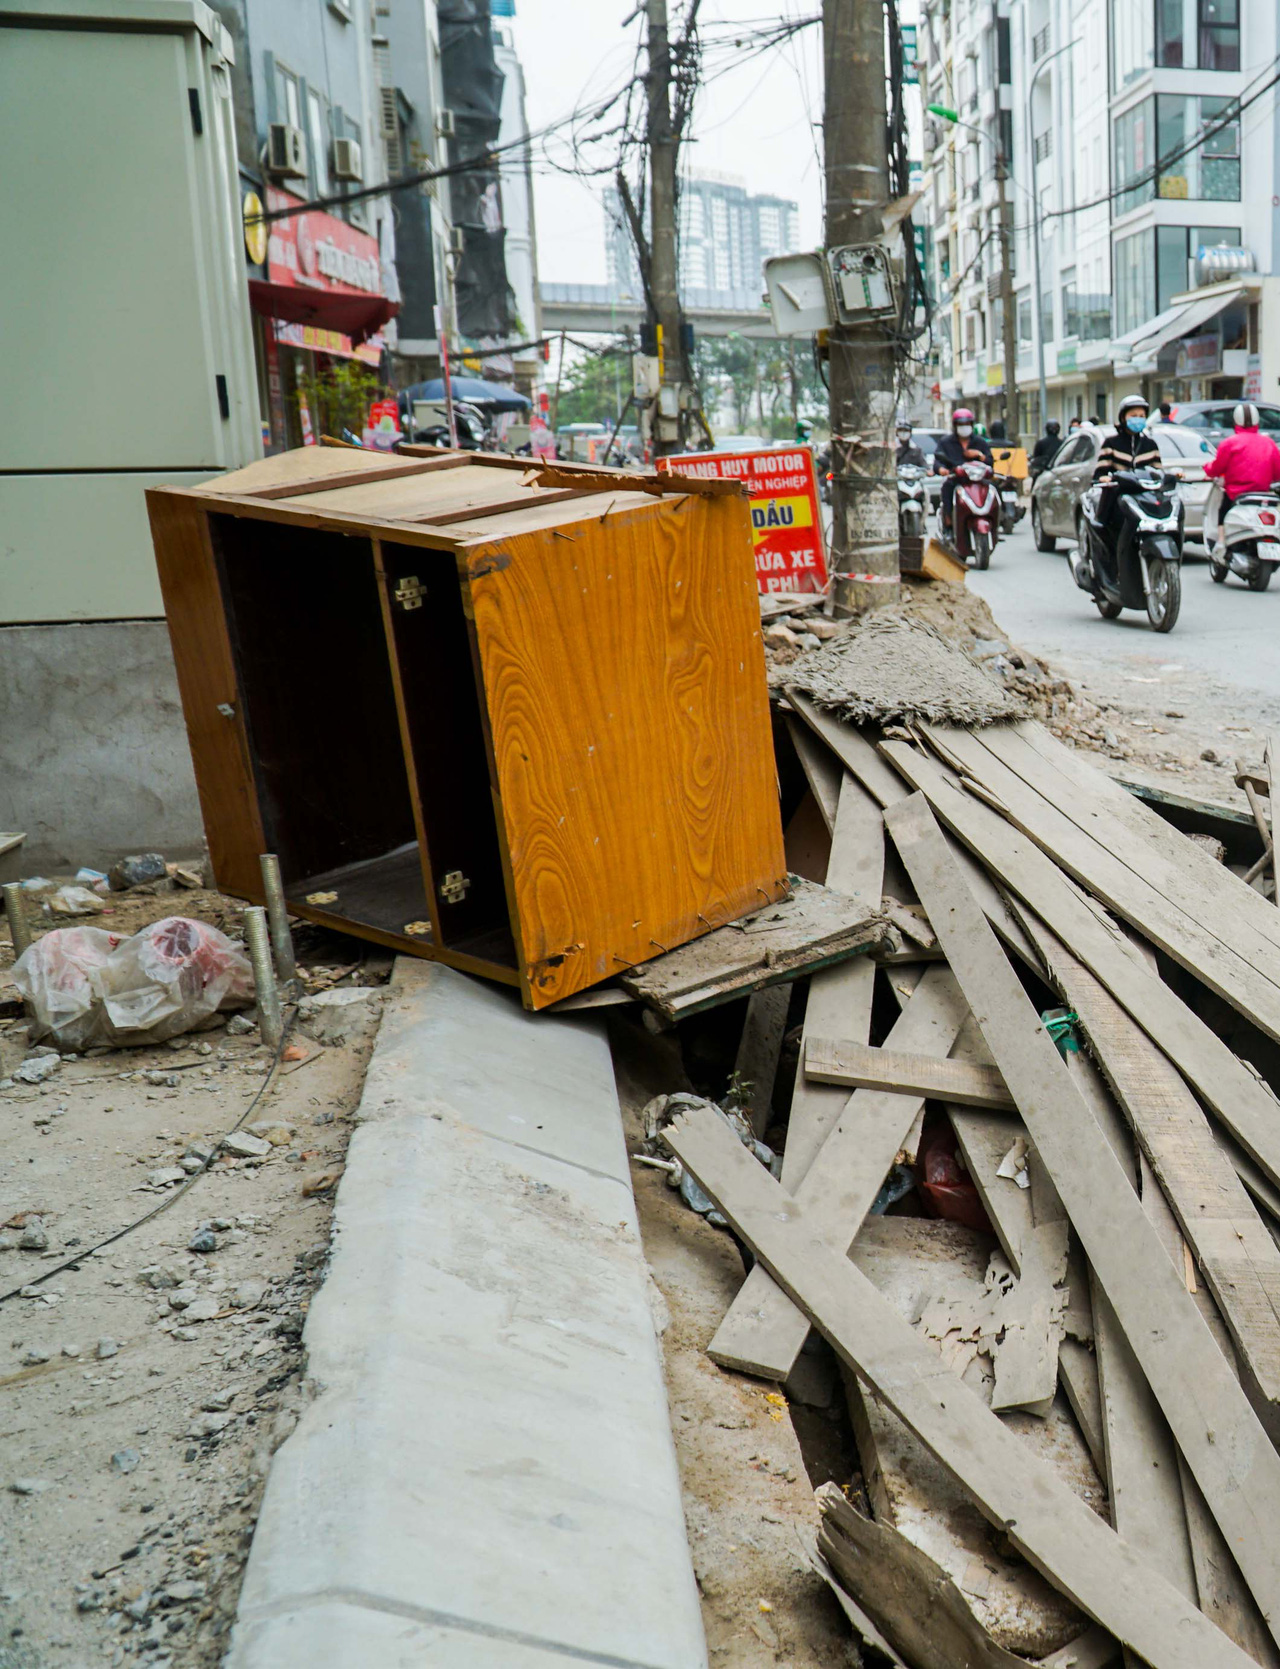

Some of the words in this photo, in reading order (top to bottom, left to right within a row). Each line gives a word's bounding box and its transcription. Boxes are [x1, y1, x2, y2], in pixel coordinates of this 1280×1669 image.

[720, 459, 748, 476] HUY
[753, 454, 804, 474] MOTOR
[790, 549, 816, 568] XE
